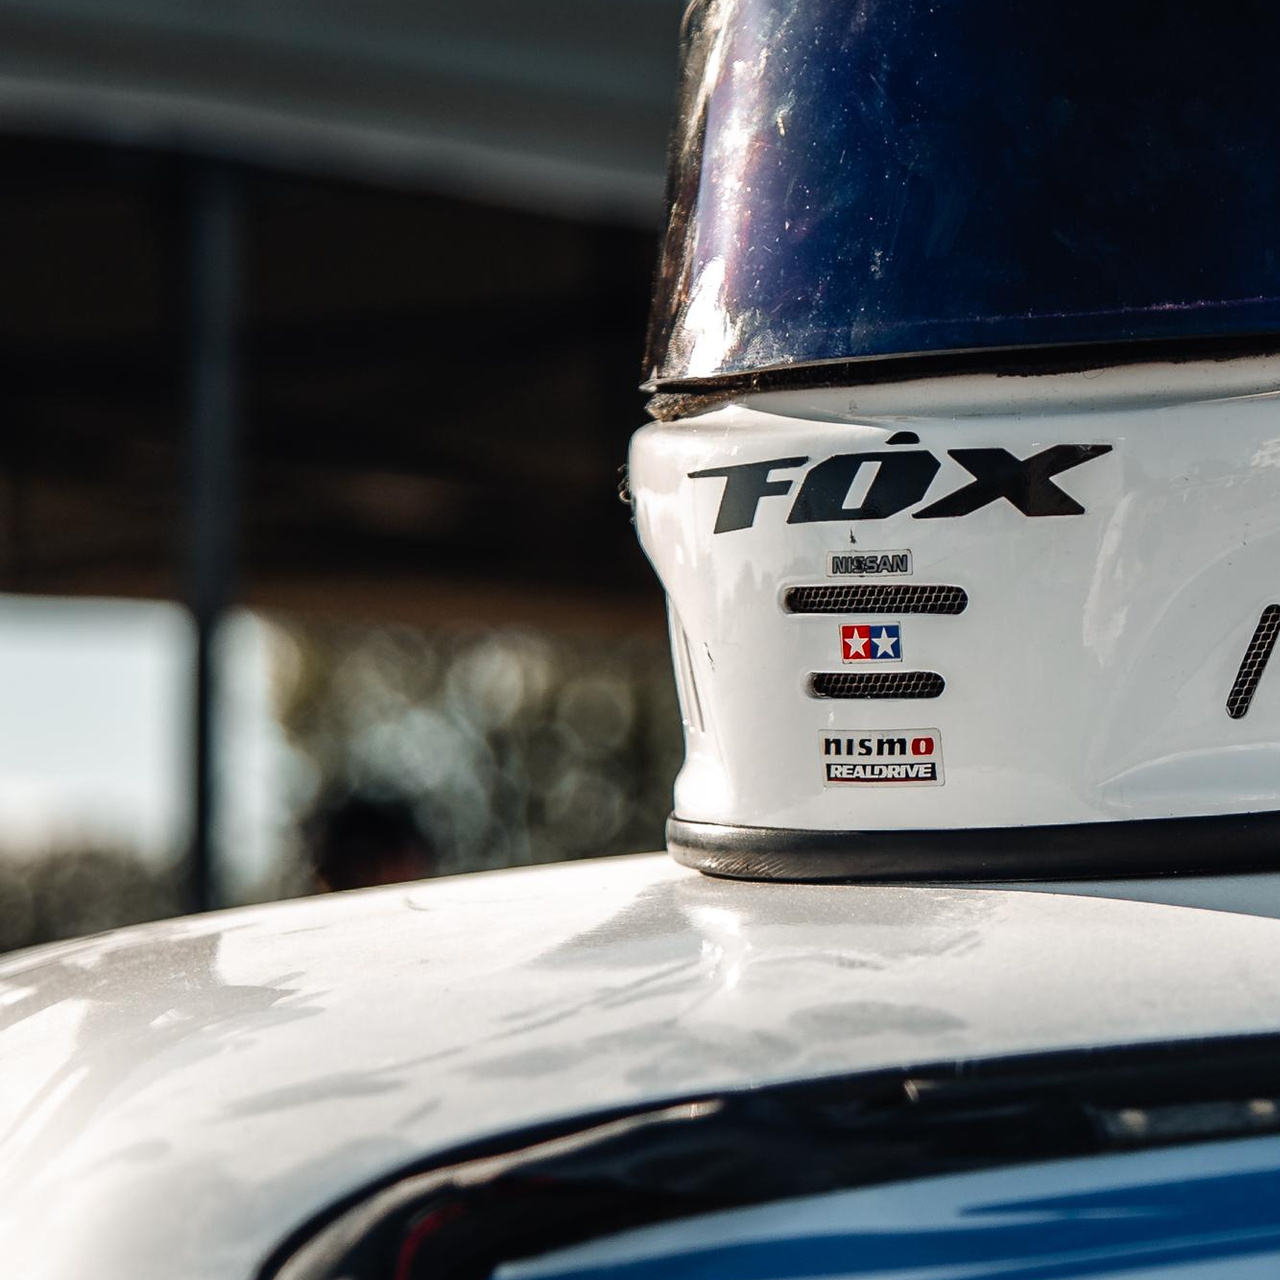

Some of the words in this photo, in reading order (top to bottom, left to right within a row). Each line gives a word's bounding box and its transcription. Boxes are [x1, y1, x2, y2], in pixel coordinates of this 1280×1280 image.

[687, 443, 1114, 534] FOX
[831, 554, 909, 575] NISSAN
[823, 737, 935, 757] nismo
